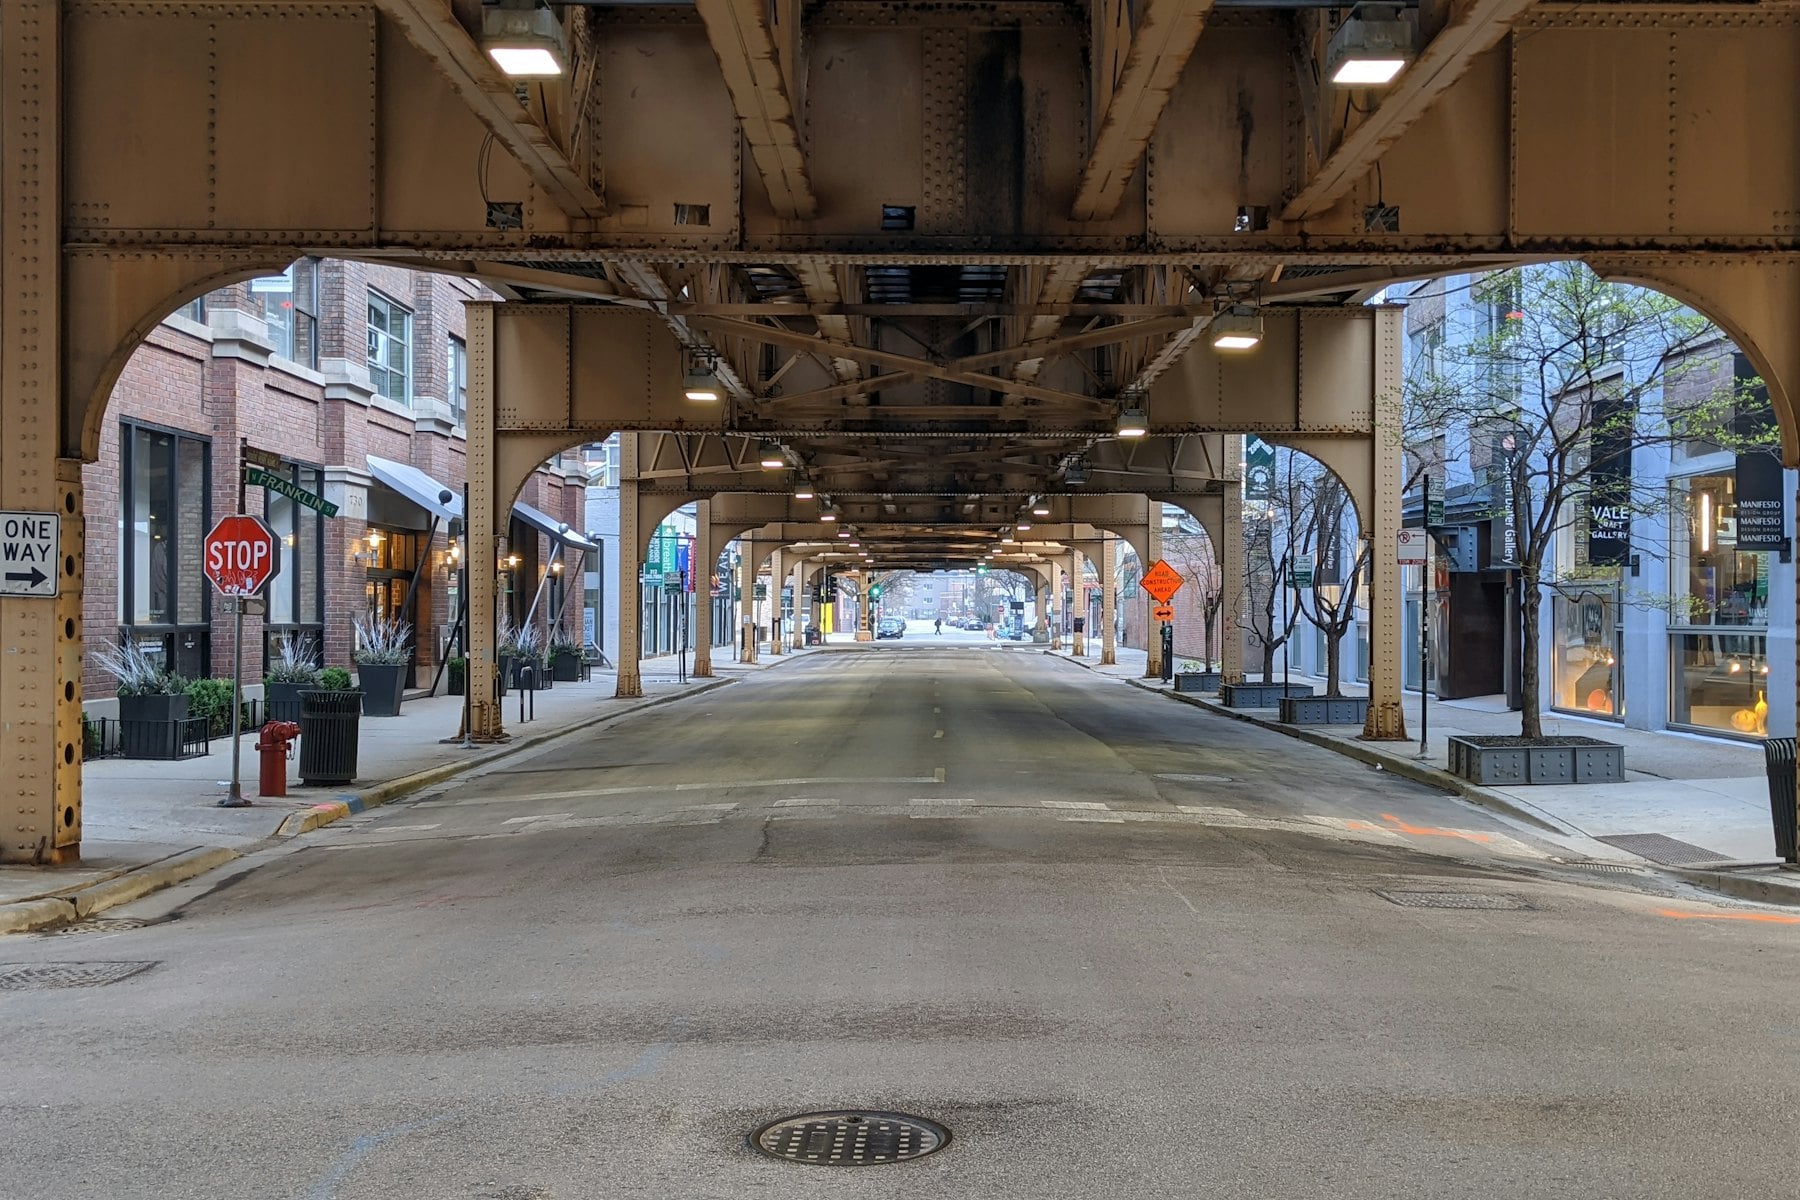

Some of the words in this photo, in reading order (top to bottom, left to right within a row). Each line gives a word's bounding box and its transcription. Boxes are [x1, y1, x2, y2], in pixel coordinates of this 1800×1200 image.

[257, 473, 325, 512] FRANKLIN
[325, 505, 336, 514] ST
[1592, 505, 1629, 520] VALE
[1740, 500, 1781, 509] MANIFESTO
[5, 519, 51, 539] ONE
[1740, 517, 1781, 526] MANIFESTO
[1502, 529, 1517, 564] Gallery
[1740, 534, 1781, 543] MANIFESTO
[3, 542, 52, 562] WAY
[209, 540, 268, 570] STOP
[1142, 578, 1182, 586] CONSTRUCTION
